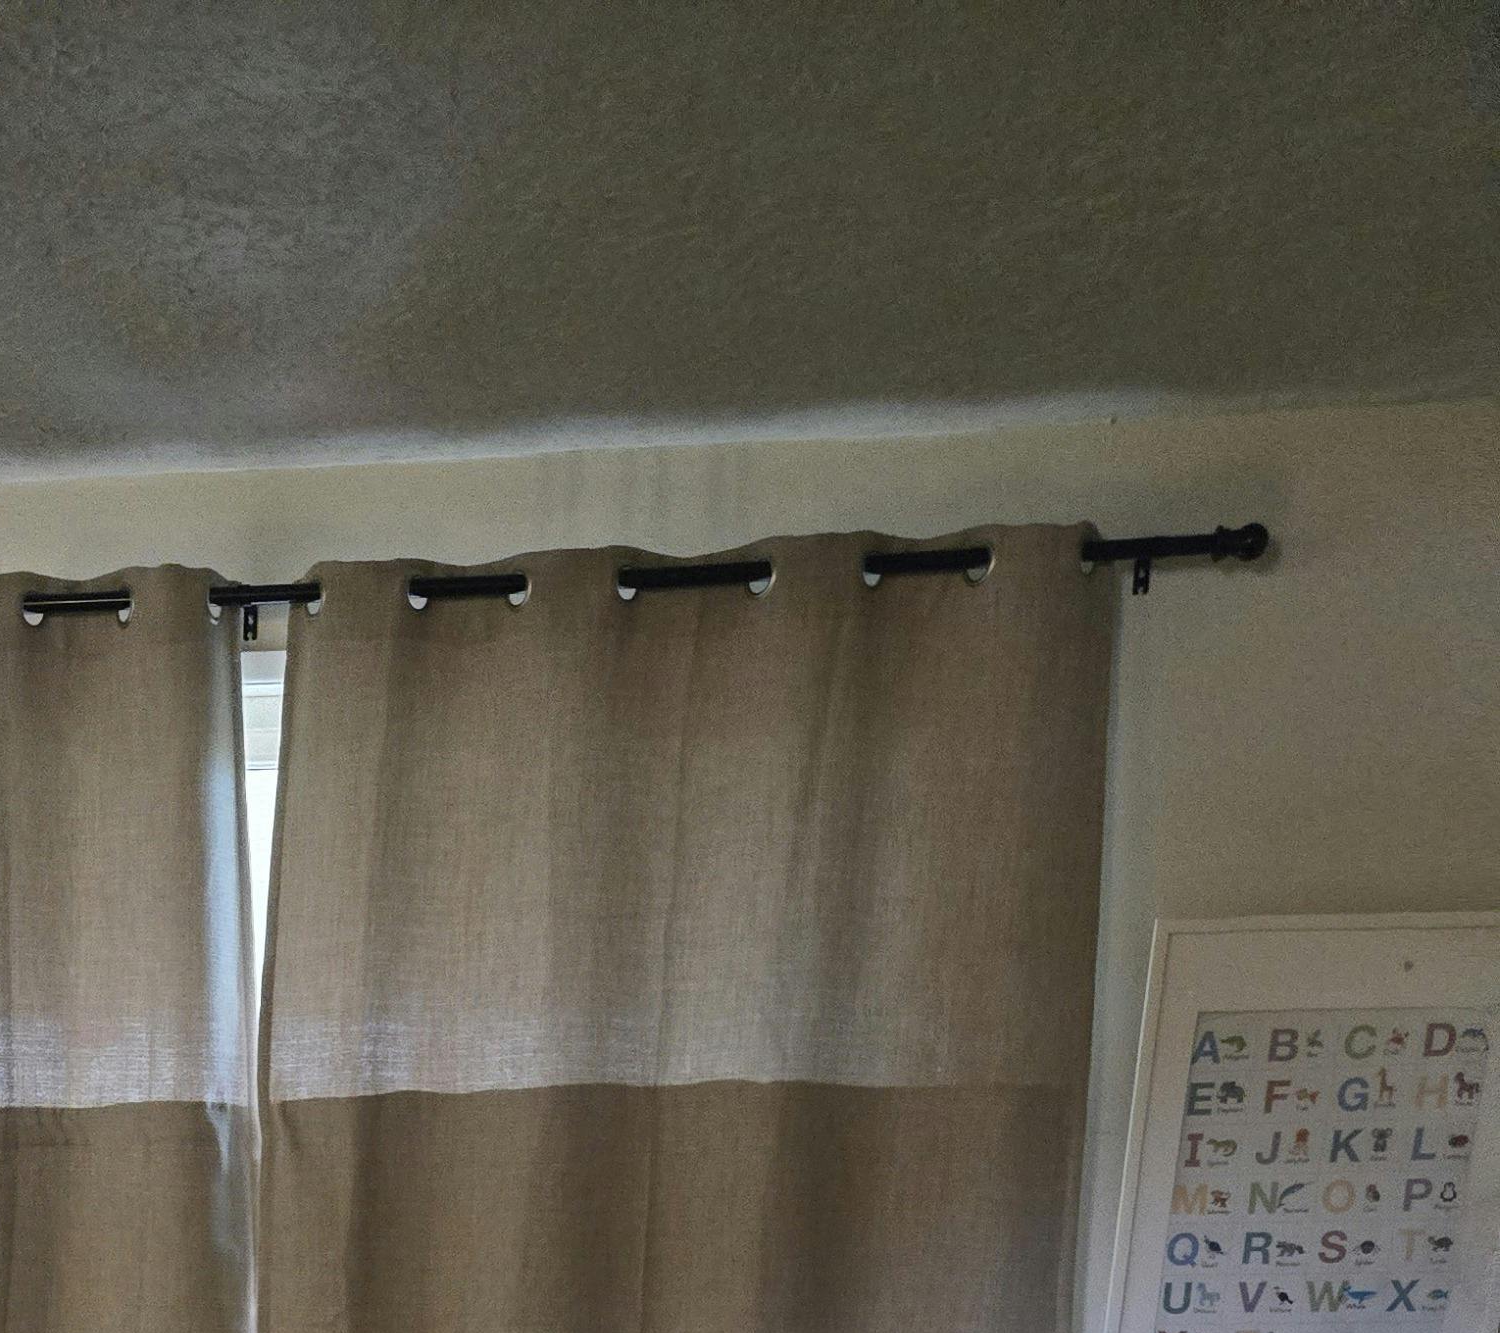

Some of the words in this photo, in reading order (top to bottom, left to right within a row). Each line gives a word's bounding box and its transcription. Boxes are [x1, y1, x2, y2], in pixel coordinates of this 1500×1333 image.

[1191, 1031, 1220, 1065] A
[1268, 1029, 1299, 1062] B
[1345, 1024, 1377, 1059] C
[1423, 1022, 1456, 1057] D
[1187, 1082, 1215, 1115] E
[1264, 1080, 1291, 1113] F
[1337, 1076, 1369, 1112] G
[1414, 1074, 1449, 1112] H
[1184, 1133, 1204, 1167] I
[1255, 1131, 1282, 1165] J
[1329, 1129, 1362, 1162] K
[1411, 1127, 1436, 1161] L
[1172, 1183, 1208, 1215] M
[1247, 1181, 1279, 1215] N
[1323, 1179, 1355, 1214] O
[1403, 1178, 1433, 1211] P
[1167, 1232, 1199, 1267] Q
[1242, 1231, 1273, 1265] R
[1318, 1230, 1348, 1263] S
[1398, 1228, 1426, 1261] T
[1163, 1281, 1192, 1314] U
[1238, 1281, 1267, 1313] V
[1306, 1280, 1350, 1312] W
[1386, 1279, 1420, 1312] X
